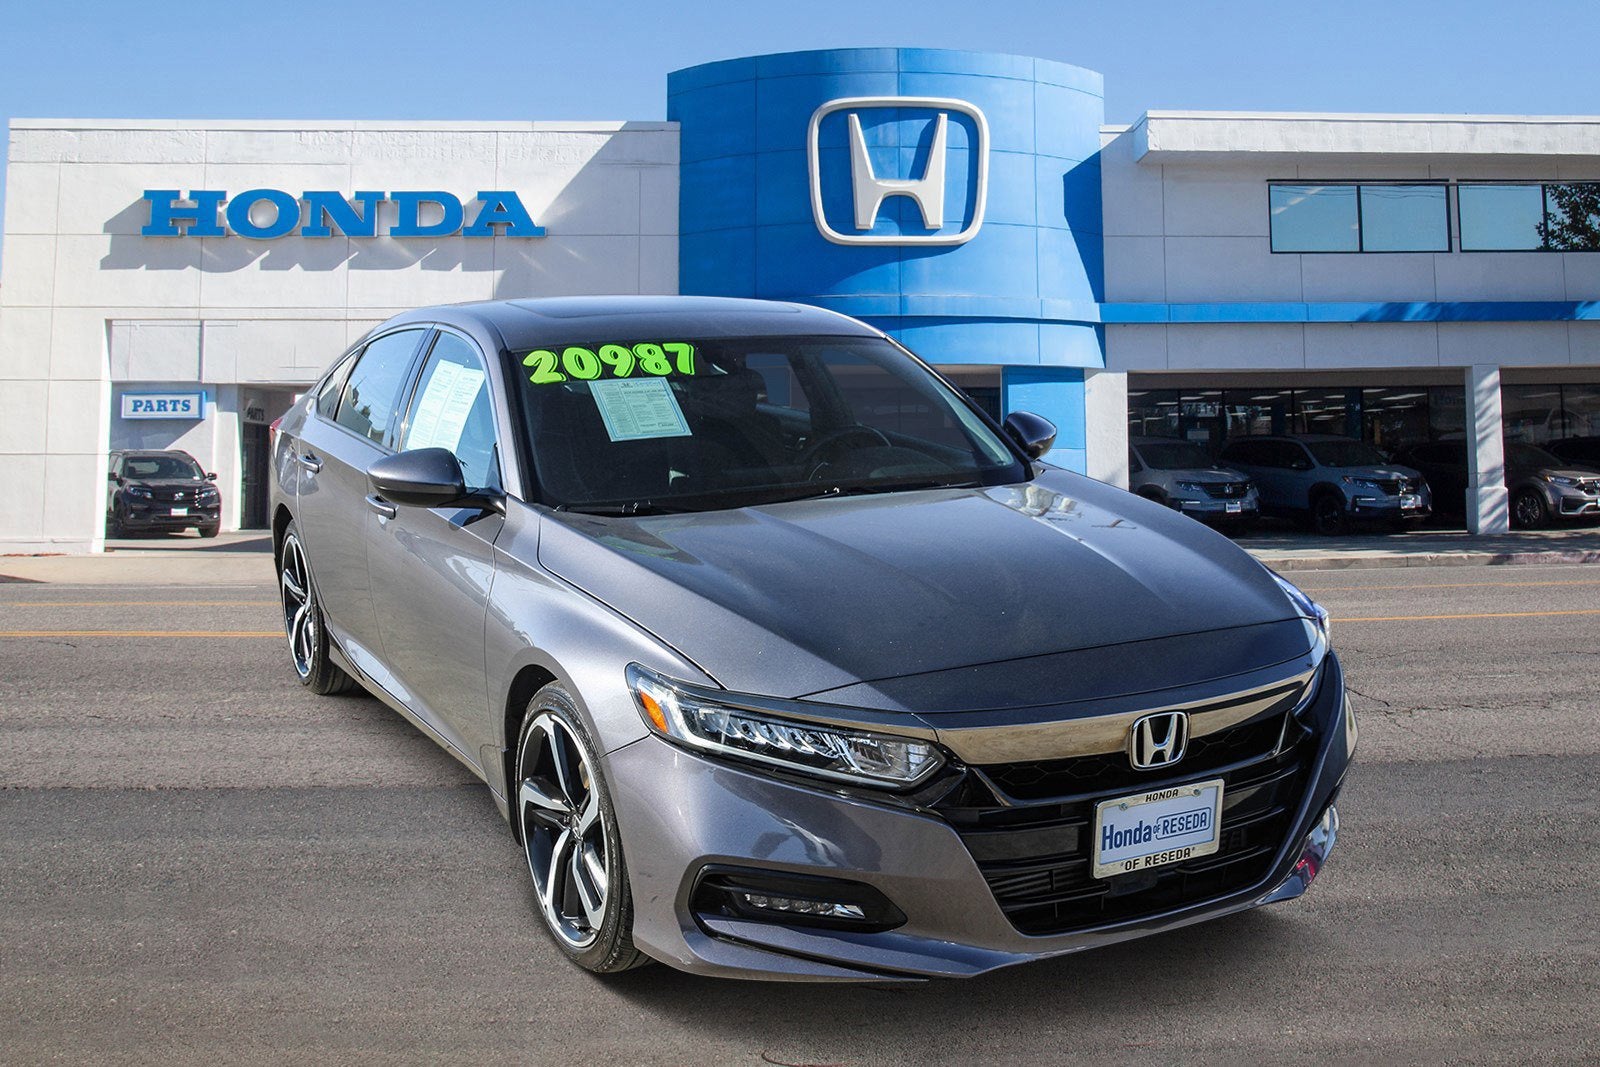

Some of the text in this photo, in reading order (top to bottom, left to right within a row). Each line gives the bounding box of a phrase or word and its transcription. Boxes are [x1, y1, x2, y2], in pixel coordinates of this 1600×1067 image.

[142, 189, 547, 239] HONDA
[523, 342, 695, 385] 20987
[132, 399, 192, 413] PARTS
[1145, 788, 1179, 803] HONDA
[1101, 820, 1152, 852] Honda
[1162, 811, 1208, 836] RESEDA
[1124, 847, 1192, 871] OF RESEDA
